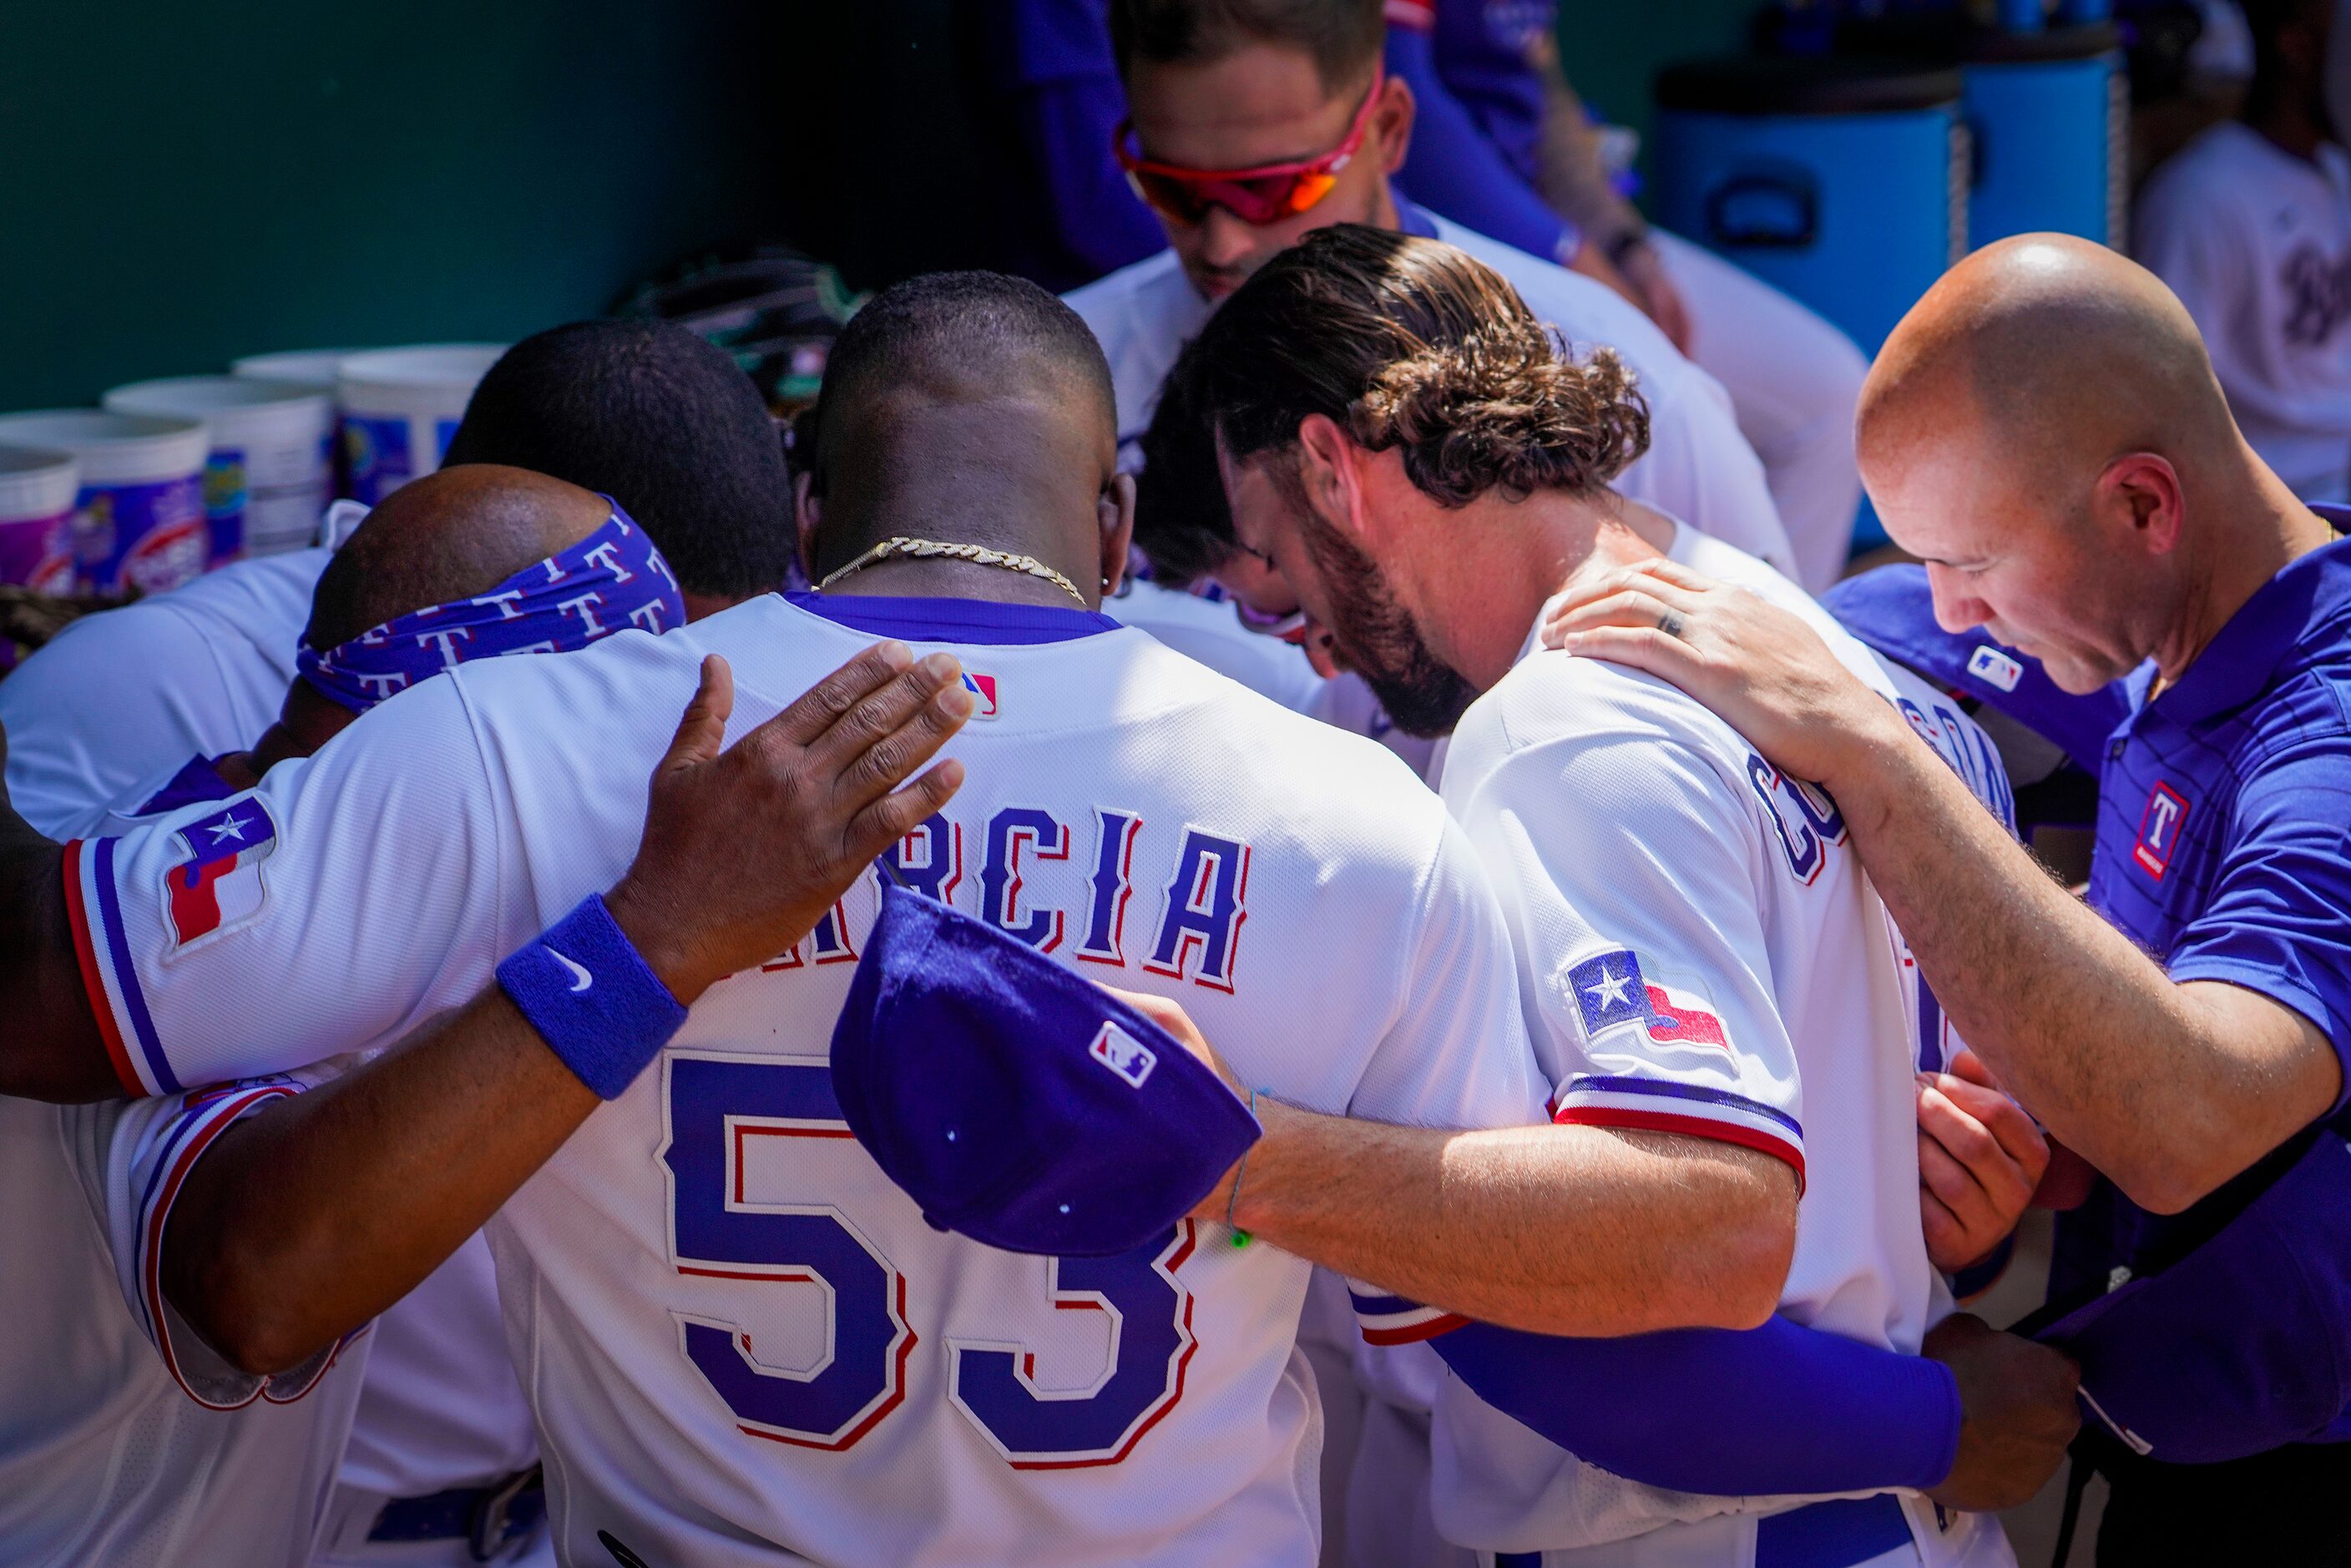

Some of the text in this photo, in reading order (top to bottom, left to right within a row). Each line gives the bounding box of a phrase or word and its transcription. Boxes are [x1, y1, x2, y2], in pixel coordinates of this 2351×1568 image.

[584, 542, 638, 585] T
[472, 589, 531, 621] T
[557, 591, 614, 639] T
[629, 598, 667, 636] T
[416, 626, 475, 669] T
[358, 671, 412, 702] T
[2152, 792, 2178, 851] T
[652, 1049, 1199, 1470] 53
